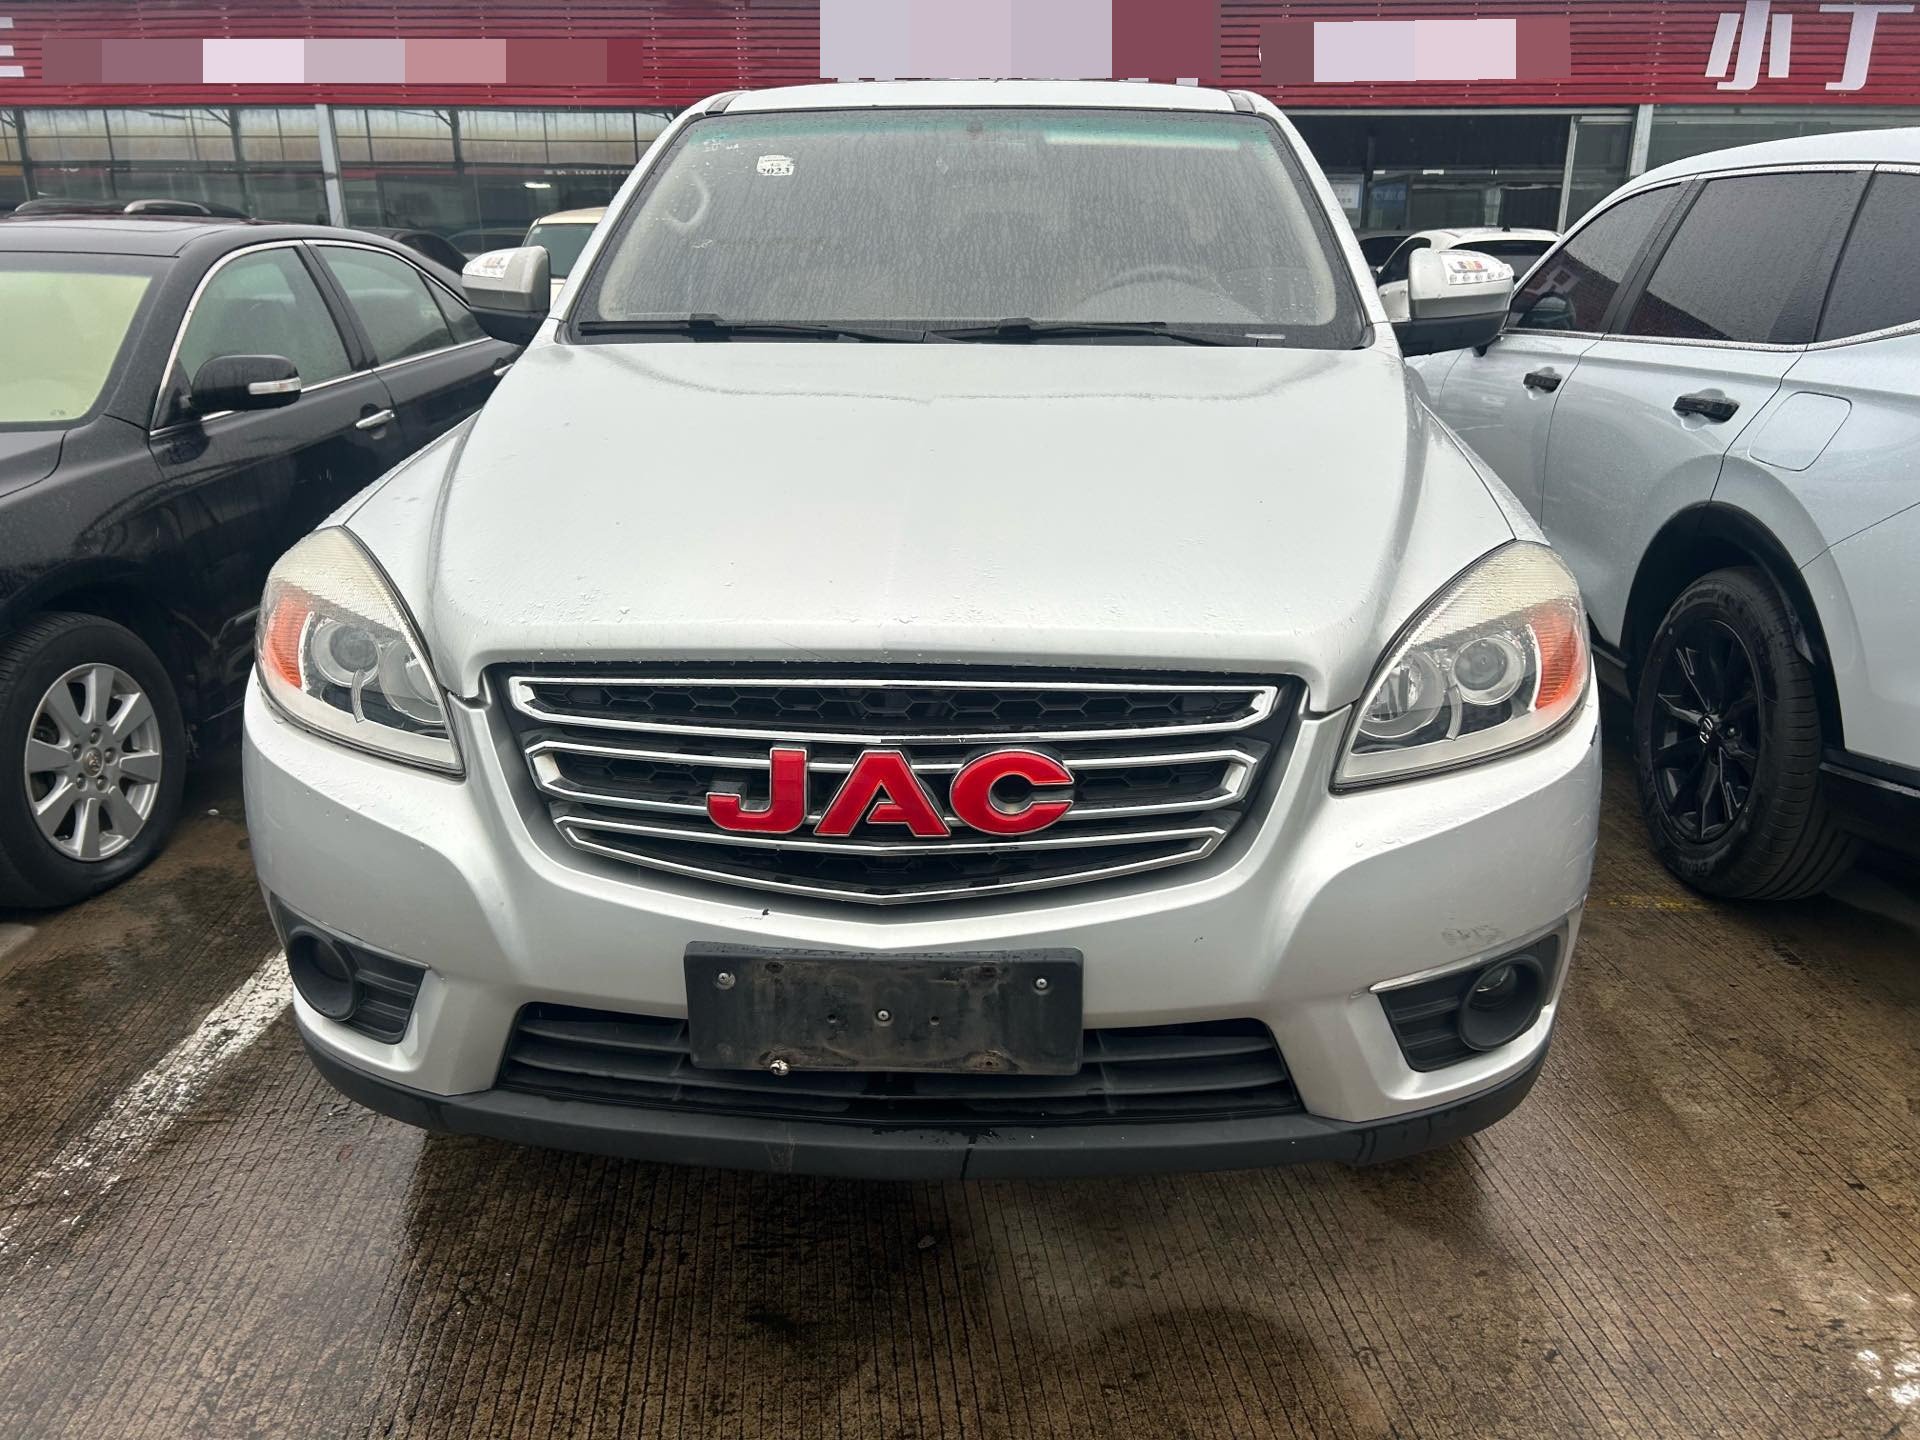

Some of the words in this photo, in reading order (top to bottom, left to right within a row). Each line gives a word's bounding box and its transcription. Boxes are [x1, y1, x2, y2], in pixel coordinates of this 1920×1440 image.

[1704, 0, 1915, 91] 小丁
[760, 167, 790, 175] 2023
[706, 746, 1075, 838] JAC
